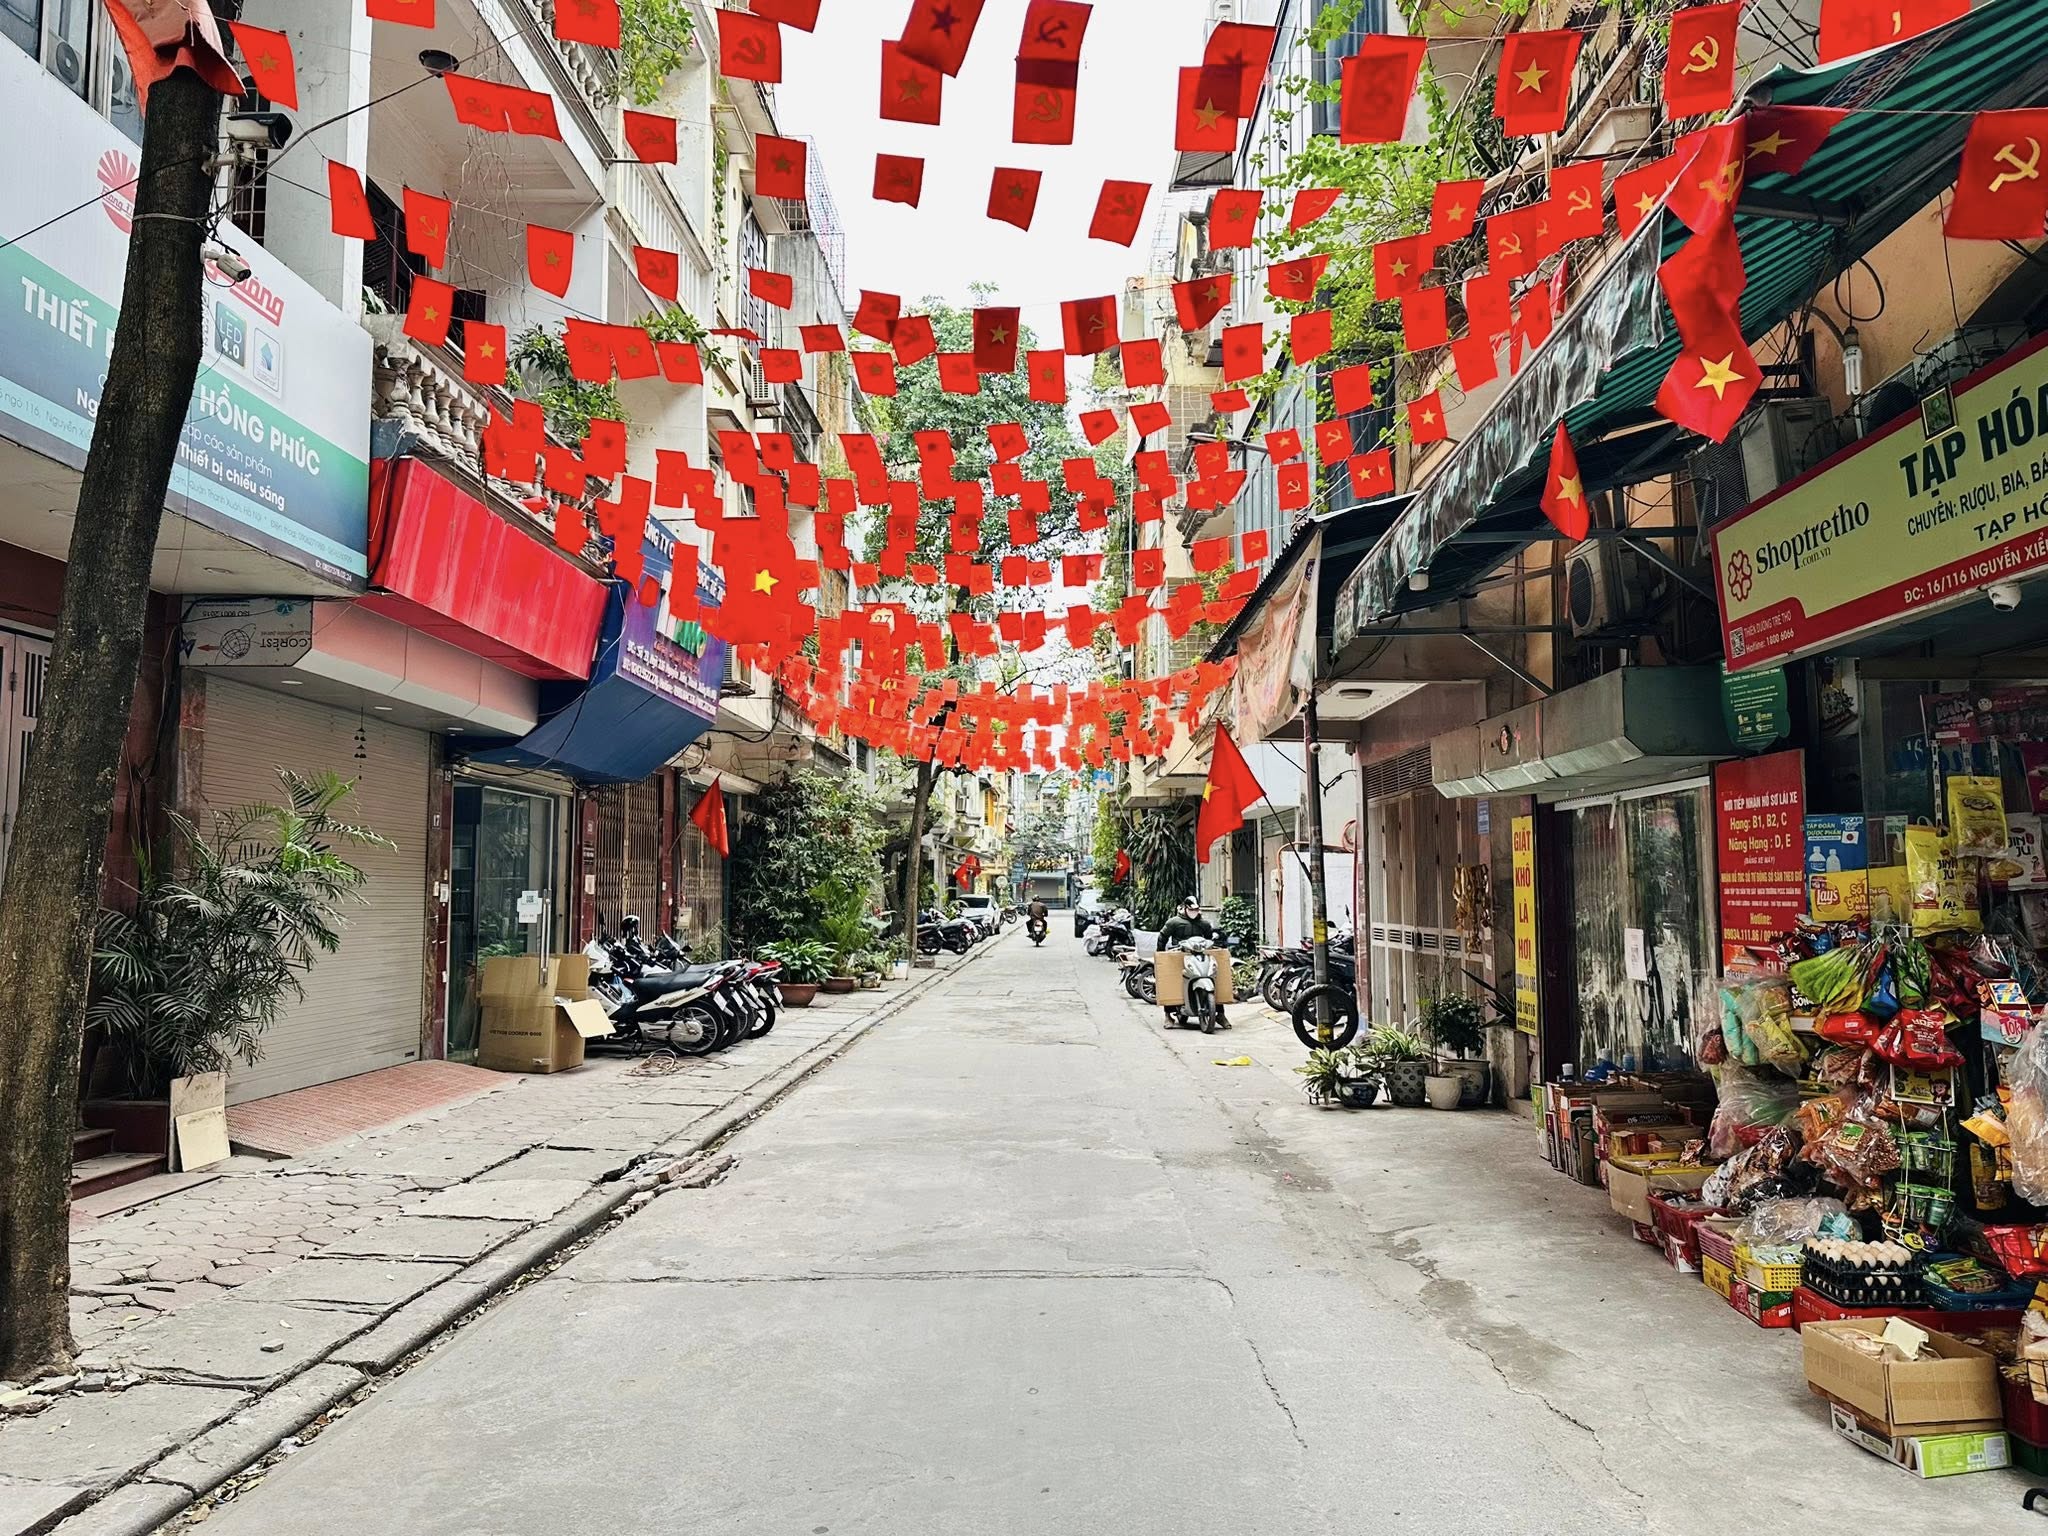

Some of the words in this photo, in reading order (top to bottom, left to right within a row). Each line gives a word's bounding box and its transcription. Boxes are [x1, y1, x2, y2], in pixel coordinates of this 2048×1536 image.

[20, 275, 98, 349] THIẾT
[218, 316, 242, 344] LED
[222, 337, 240, 360] 4.0
[200, 383, 264, 443] HỒNG
[270, 424, 320, 475] PHÚC
[203, 431, 224, 453] các
[226, 443, 244, 464] sản
[245, 454, 273, 479] phẩm
[1899, 431, 1966, 498] TẠP
[211, 456, 223, 482] bị
[225, 468, 257, 494] chiếu
[259, 484, 285, 511] sáng
[1908, 500, 1958, 537] CHUYÊN:
[1959, 481, 2000, 515] RƯỢU,
[2001, 468, 2029, 497] BIA,
[1755, 501, 1870, 575] Shoptretho
[1974, 511, 2016, 542] TẠP
[1904, 585, 1926, 605] ĐC:
[1927, 569, 1968, 596] 16/116
[1969, 546, 2022, 581] NGUYỄN
[2024, 531, 2048, 563] XIỂ
[1789, 791, 1798, 804] XE
[1730, 817, 1751, 834] Hạng:
[1752, 815, 1765, 829] B1,
[1766, 813, 1779, 828] B2,
[1780, 812, 1787, 826] C
[1514, 827, 1531, 856] GIẶT
[1748, 836, 1768, 853] Hạng
[1774, 834, 1784, 850] D,
[1785, 833, 1791, 847] E
[1515, 862, 1531, 888] KHÔ
[1850, 882, 1863, 894] Số
[1519, 898, 1529, 924] LÀ
[1518, 938, 1531, 960] HƠI
